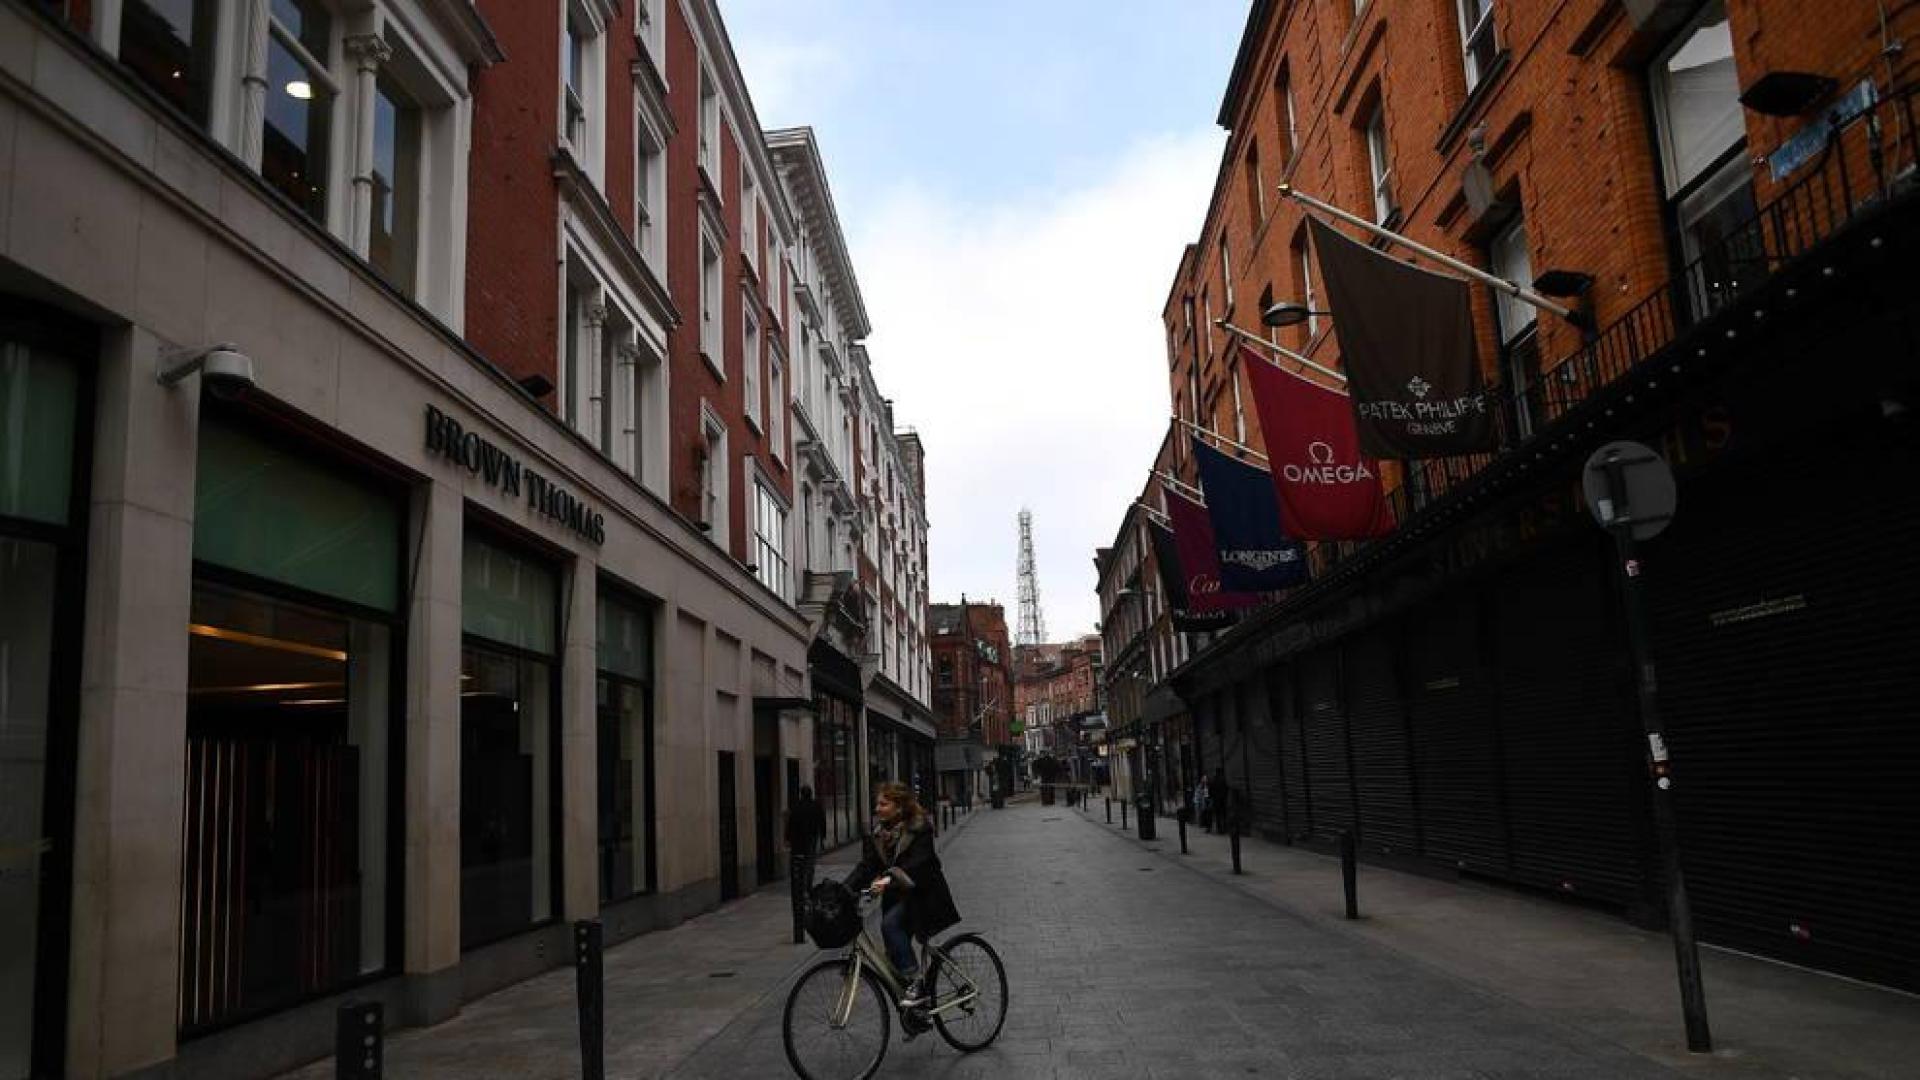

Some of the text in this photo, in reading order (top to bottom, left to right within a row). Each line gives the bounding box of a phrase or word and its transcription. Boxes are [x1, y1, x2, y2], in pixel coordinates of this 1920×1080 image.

[1358, 400, 1413, 420] PATEK
[426, 403, 604, 545] BROWN THOMAS
[1283, 463, 1374, 484] OMEGA
